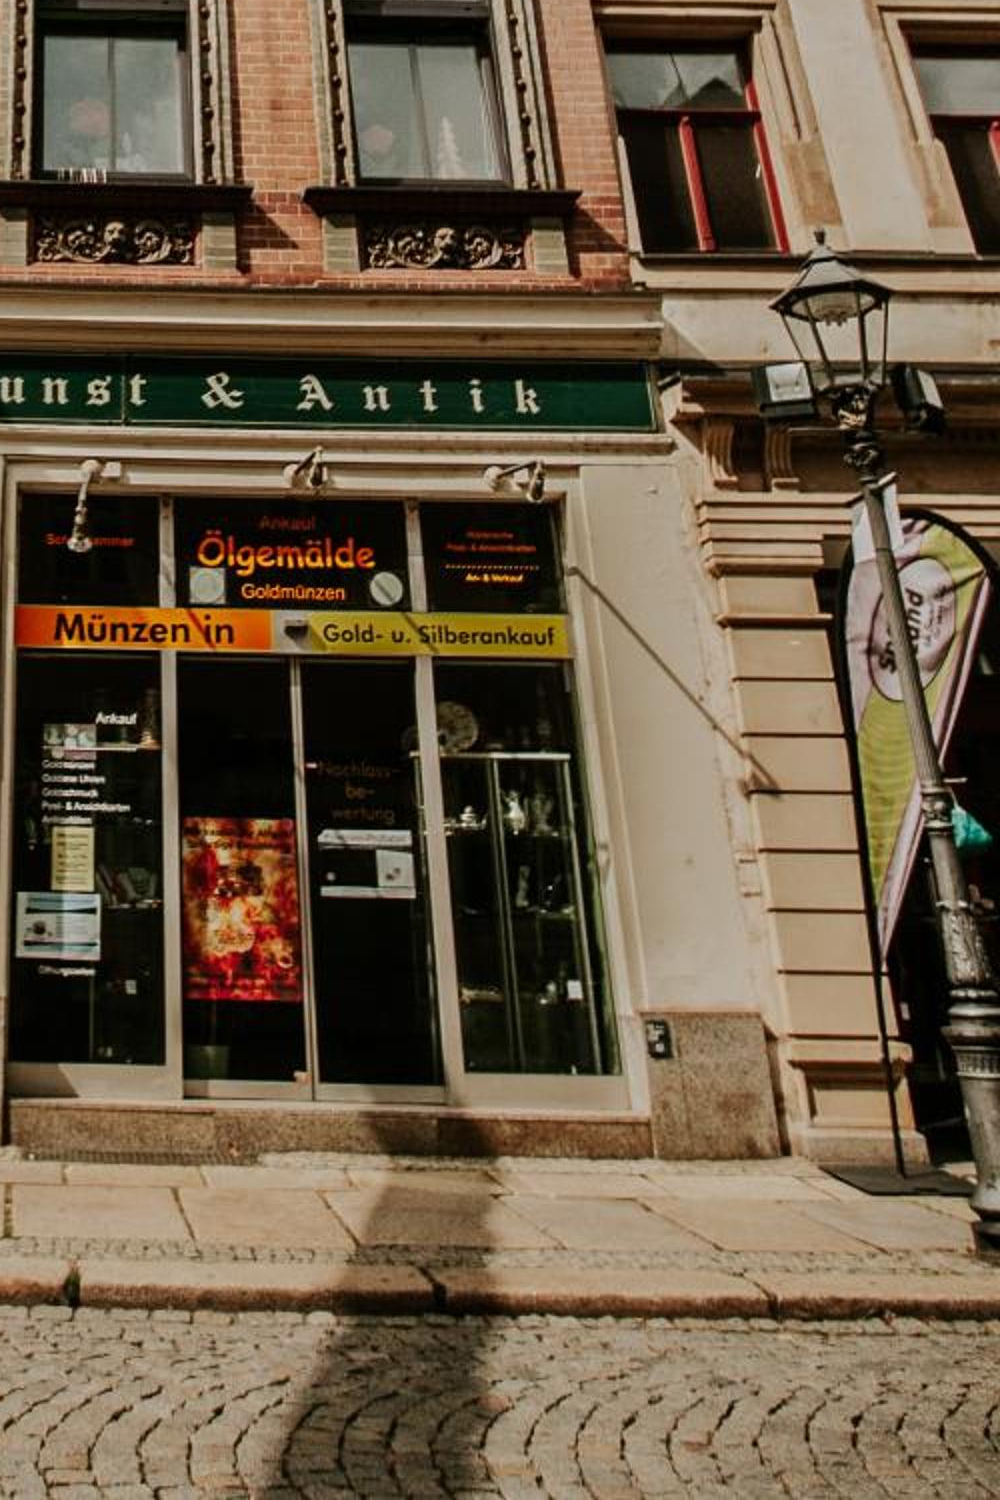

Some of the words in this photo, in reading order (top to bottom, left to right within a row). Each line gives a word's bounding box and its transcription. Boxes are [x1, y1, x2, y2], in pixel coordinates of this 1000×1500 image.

[201, 371, 244, 409] &
[296, 374, 541, 415] Antik
[196, 529, 377, 578] Ölgemälde
[240, 583, 346, 601] Goldmünzen
[54, 613, 191, 644] Münzen
[203, 615, 235, 644] in
[323, 623, 384, 643] Gold-
[391, 630, 412, 644] u.
[418, 626, 555, 646] Silberankauf
[95, 712, 138, 726] Ankauf
